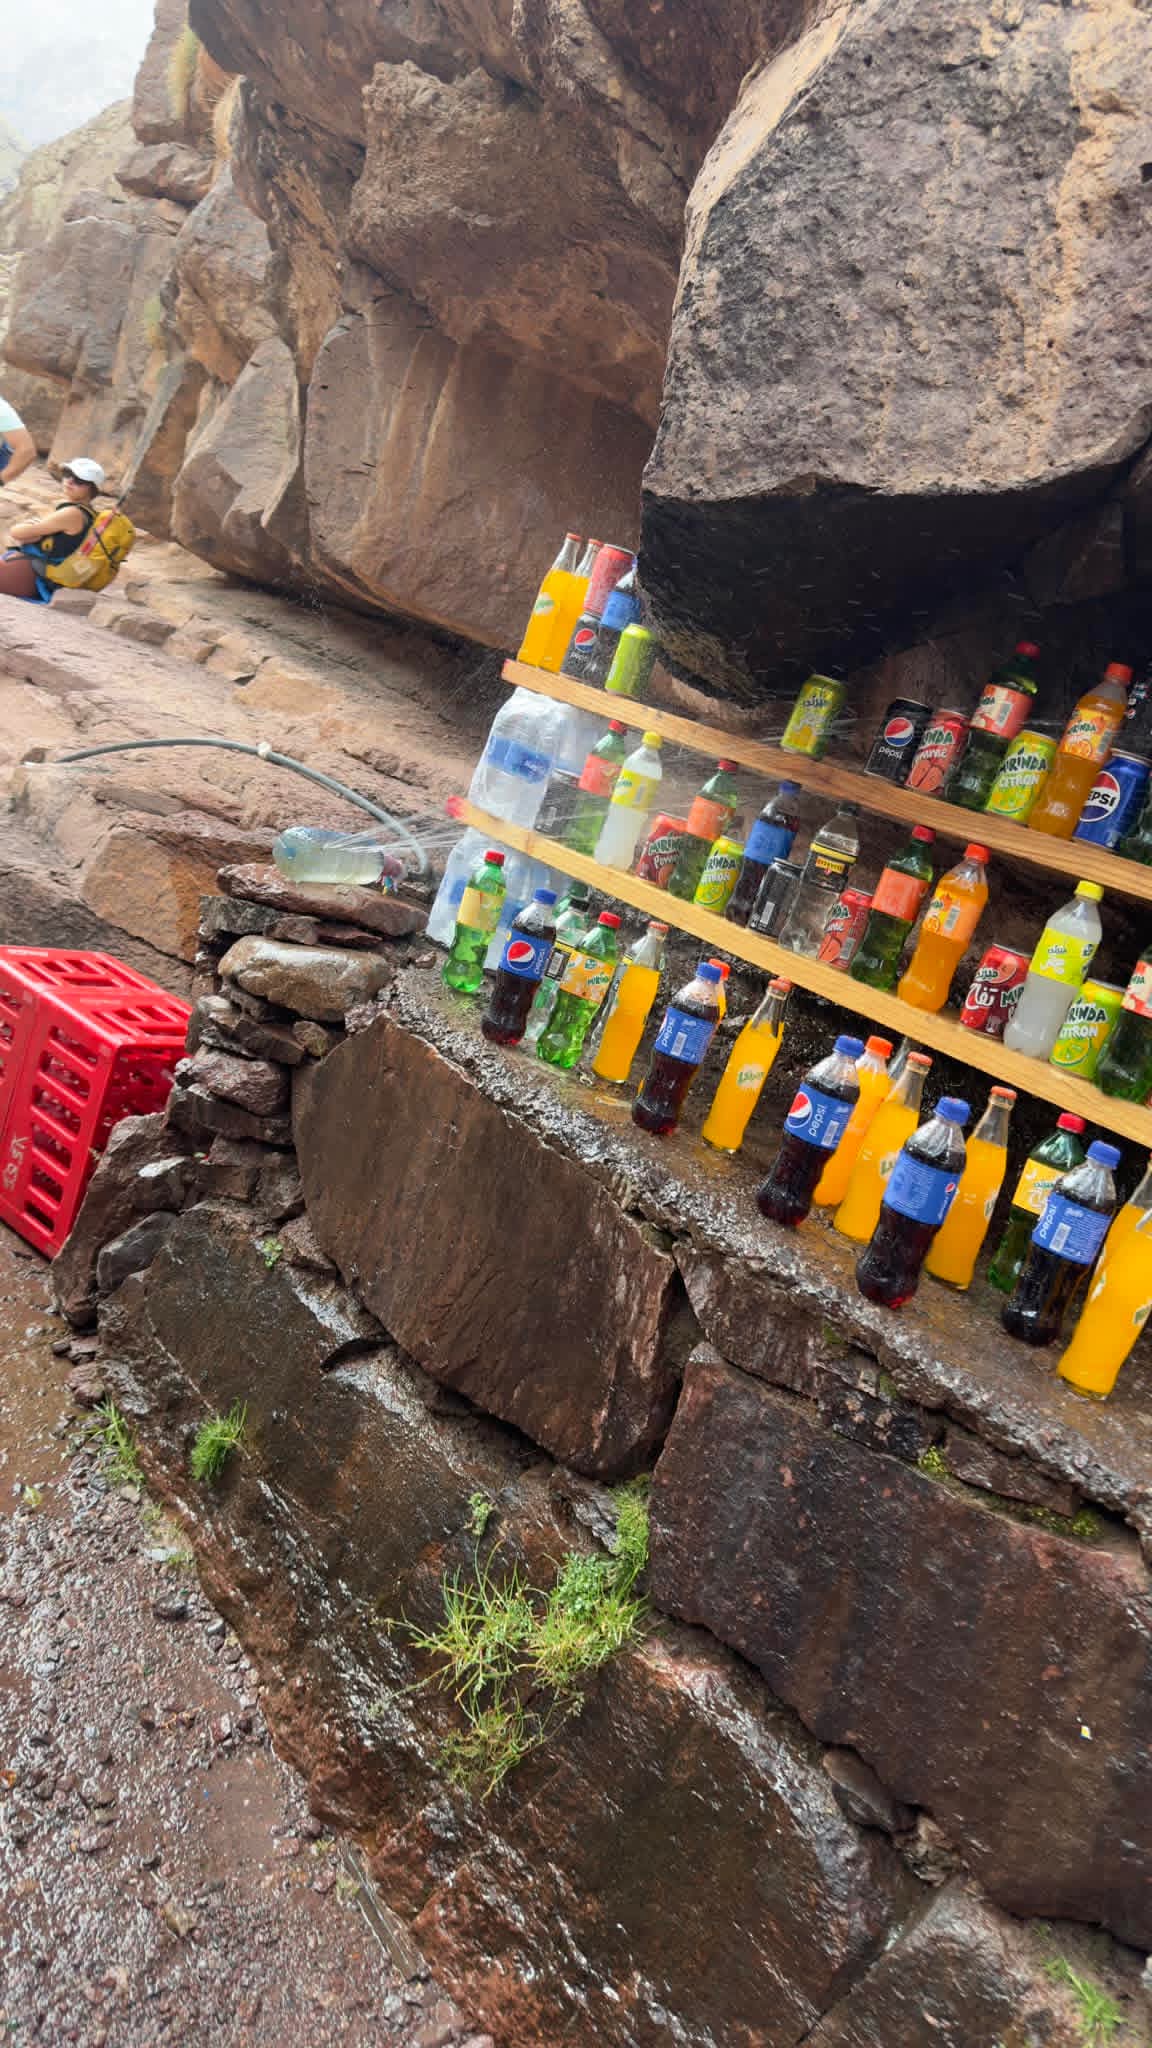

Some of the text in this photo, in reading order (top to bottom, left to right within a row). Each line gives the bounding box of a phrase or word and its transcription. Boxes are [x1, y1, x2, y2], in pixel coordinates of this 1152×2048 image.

[879, 746, 904, 760] pepsi
[807, 1104, 827, 1137] pepsi
[1039, 1203, 1057, 1240] pepsi
